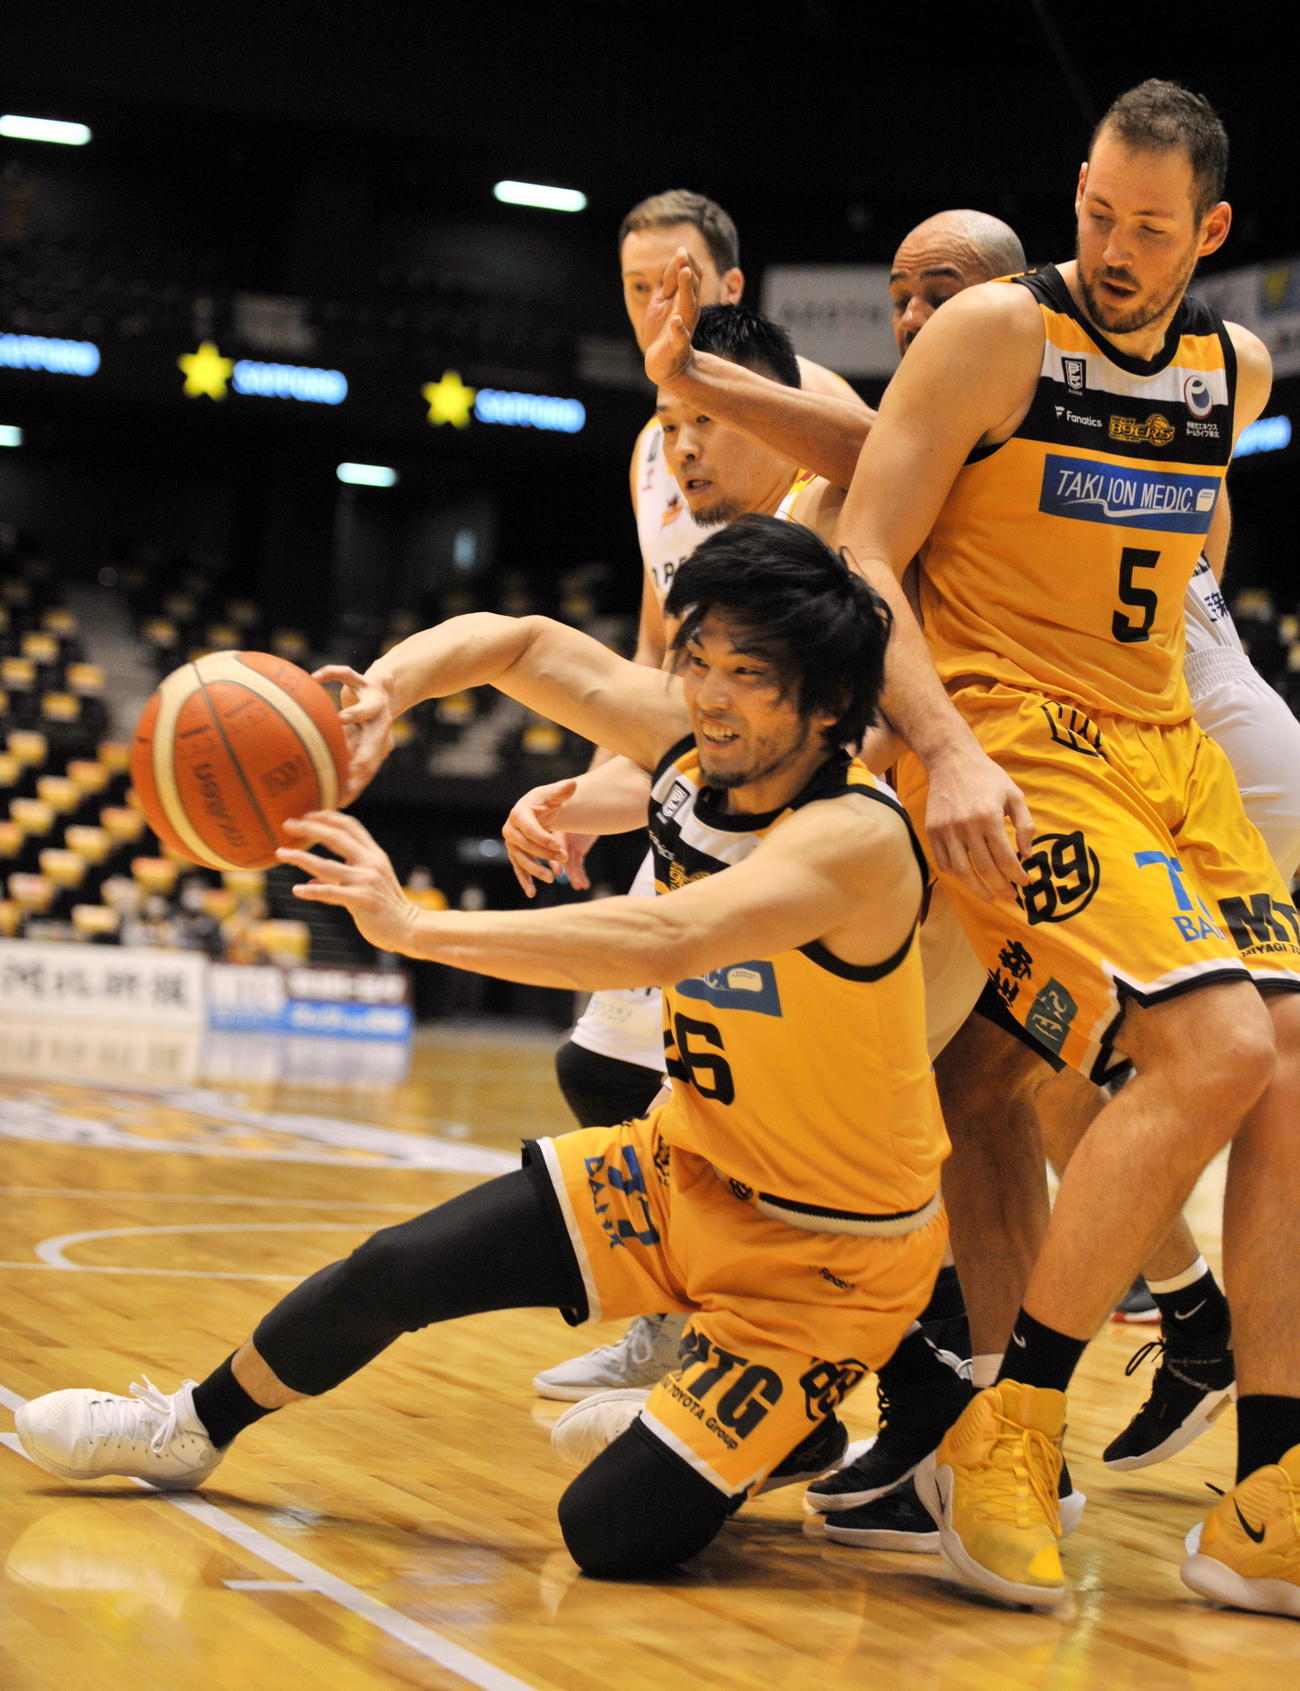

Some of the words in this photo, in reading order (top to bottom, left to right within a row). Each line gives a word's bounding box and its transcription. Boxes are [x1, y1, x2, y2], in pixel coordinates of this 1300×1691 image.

[1066, 411, 1103, 427] Fanatics
[1140, 483, 1193, 512] MEDIC
[1112, 547, 1161, 643] 5
[1021, 831, 1090, 925] 89
[672, 1384, 705, 1421] TOYOTA
[705, 1417, 738, 1450] Group
